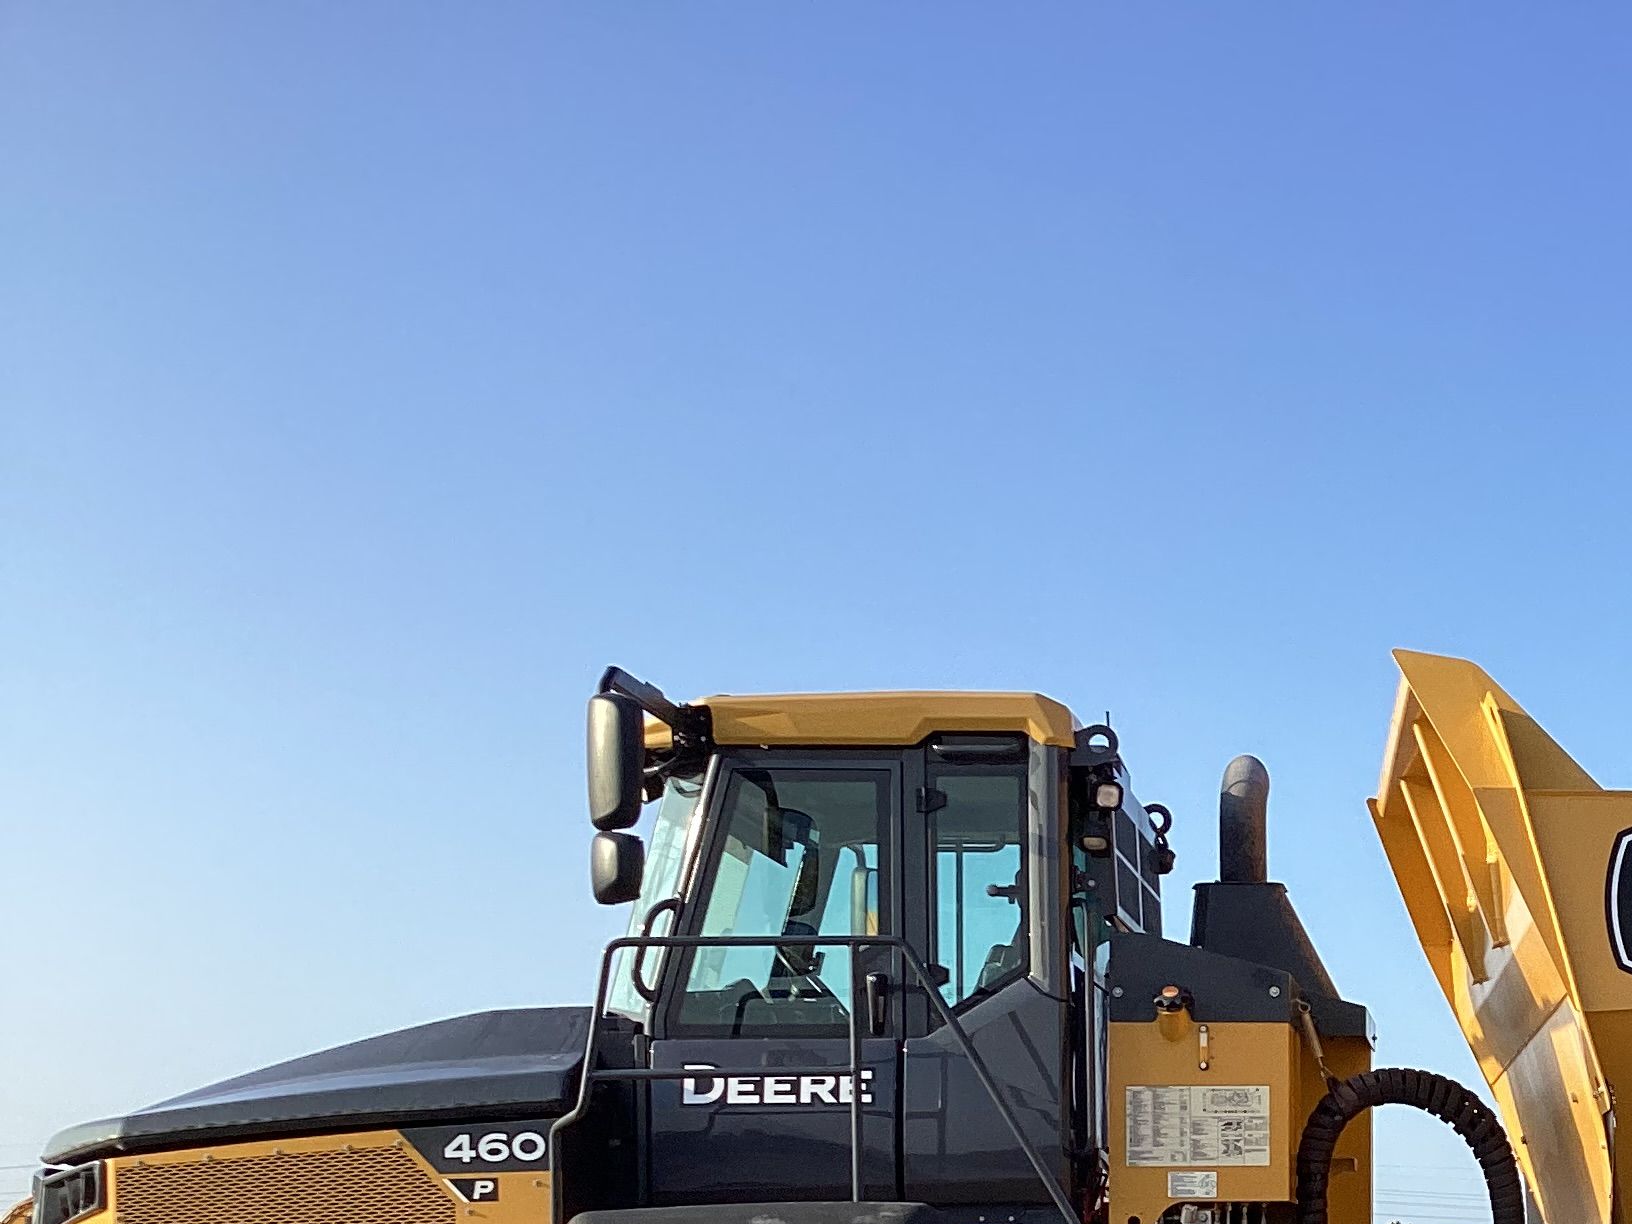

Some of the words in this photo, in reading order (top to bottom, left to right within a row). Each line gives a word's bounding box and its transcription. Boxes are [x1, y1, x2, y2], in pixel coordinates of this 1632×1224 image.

[683, 1064, 873, 1105] DEERE
[444, 1131, 546, 1163] 460
[472, 1180, 495, 1200] P
